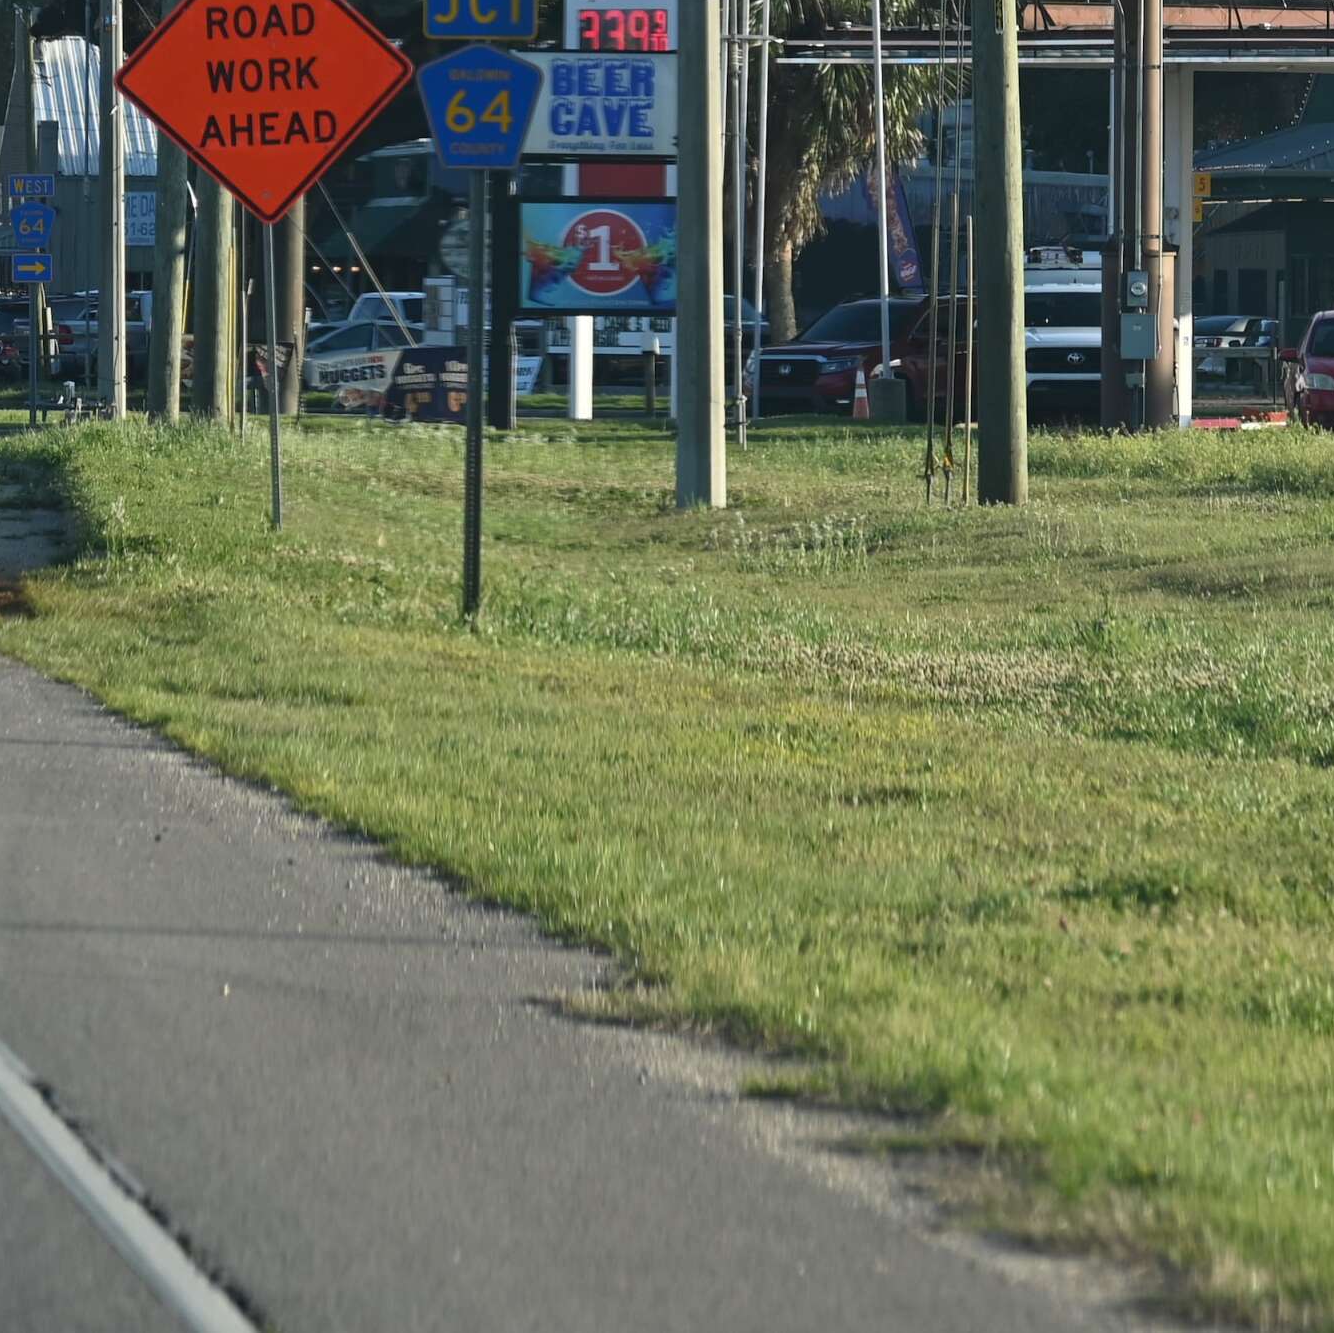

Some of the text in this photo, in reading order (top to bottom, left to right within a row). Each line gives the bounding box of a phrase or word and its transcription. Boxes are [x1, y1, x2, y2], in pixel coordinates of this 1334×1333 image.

[205, 3, 316, 40] ROAD
[206, 56, 320, 94] WORK
[551, 57, 655, 97] BEER
[200, 110, 338, 149] AHEAD
[445, 89, 513, 135] 64
[550, 97, 655, 138] CAVE
[13, 178, 50, 194] WEST
[19, 218, 44, 234] 64
[319, 364, 386, 385] NUGGETS
